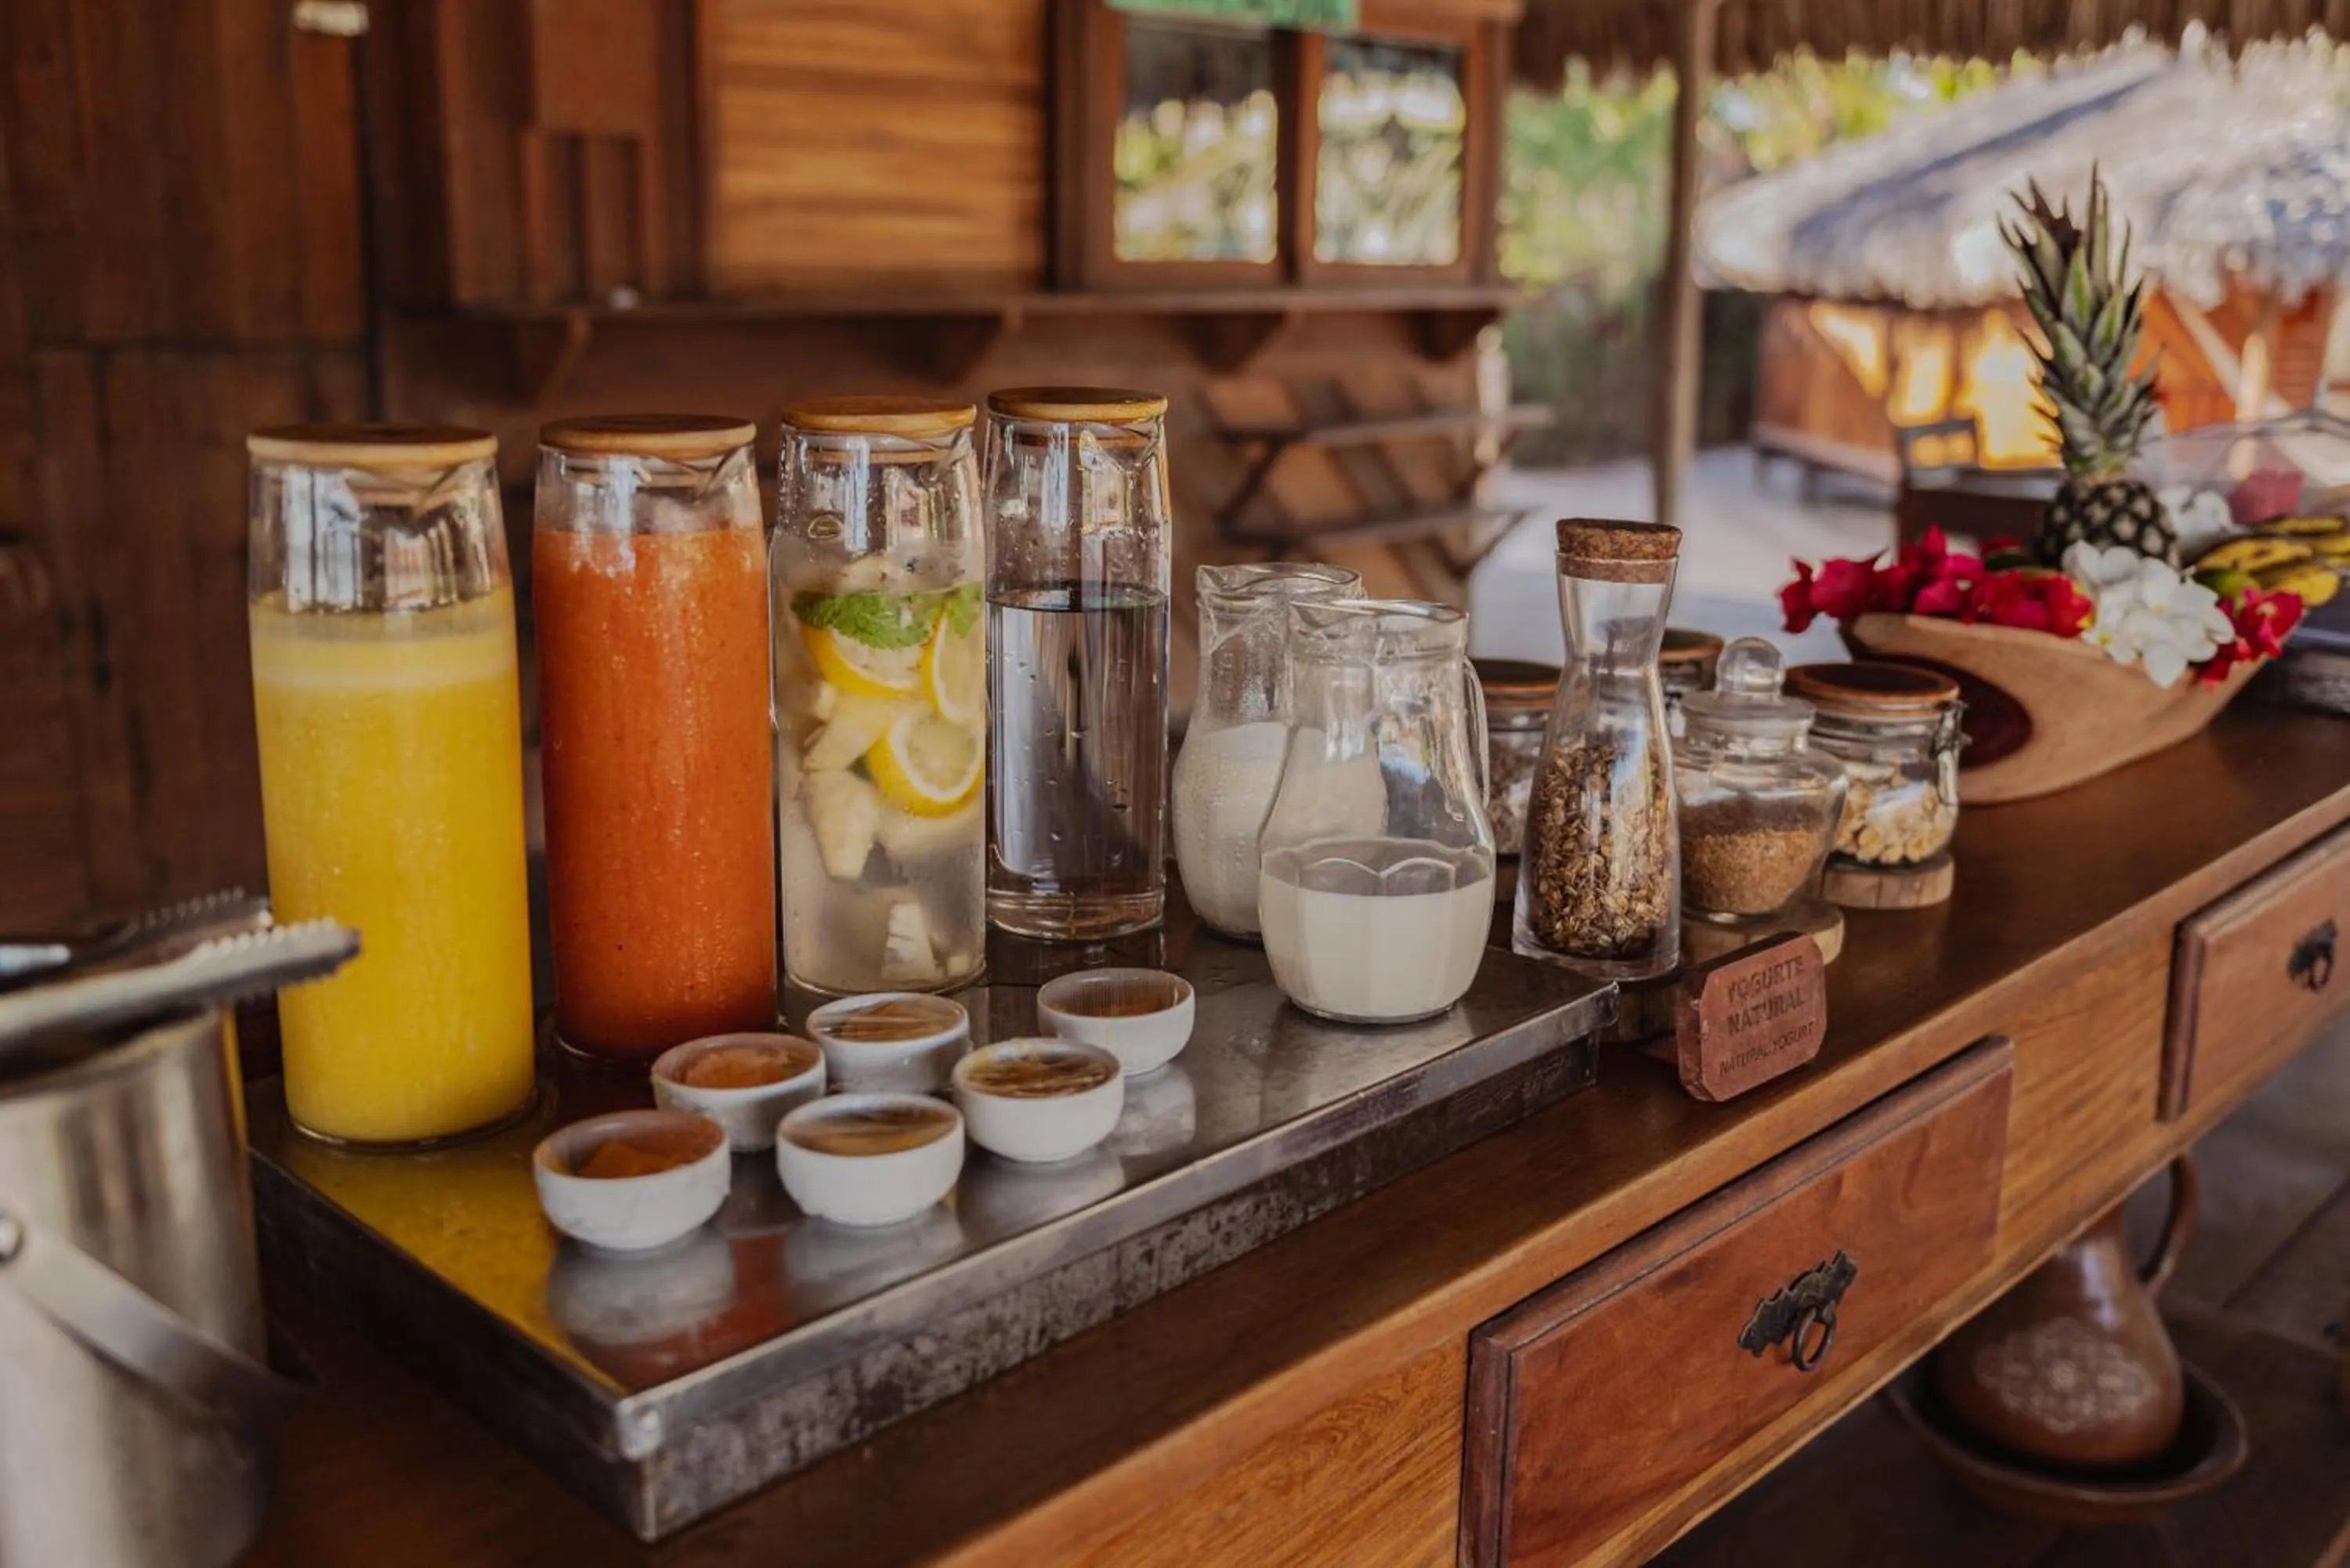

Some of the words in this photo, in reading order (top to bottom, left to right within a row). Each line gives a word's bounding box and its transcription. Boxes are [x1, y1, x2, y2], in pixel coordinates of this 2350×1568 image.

[1727, 955, 1805, 1003] YOGURTE
[1727, 986, 1805, 1036] NATURAL
[1772, 1021, 1815, 1055] YOGURT
